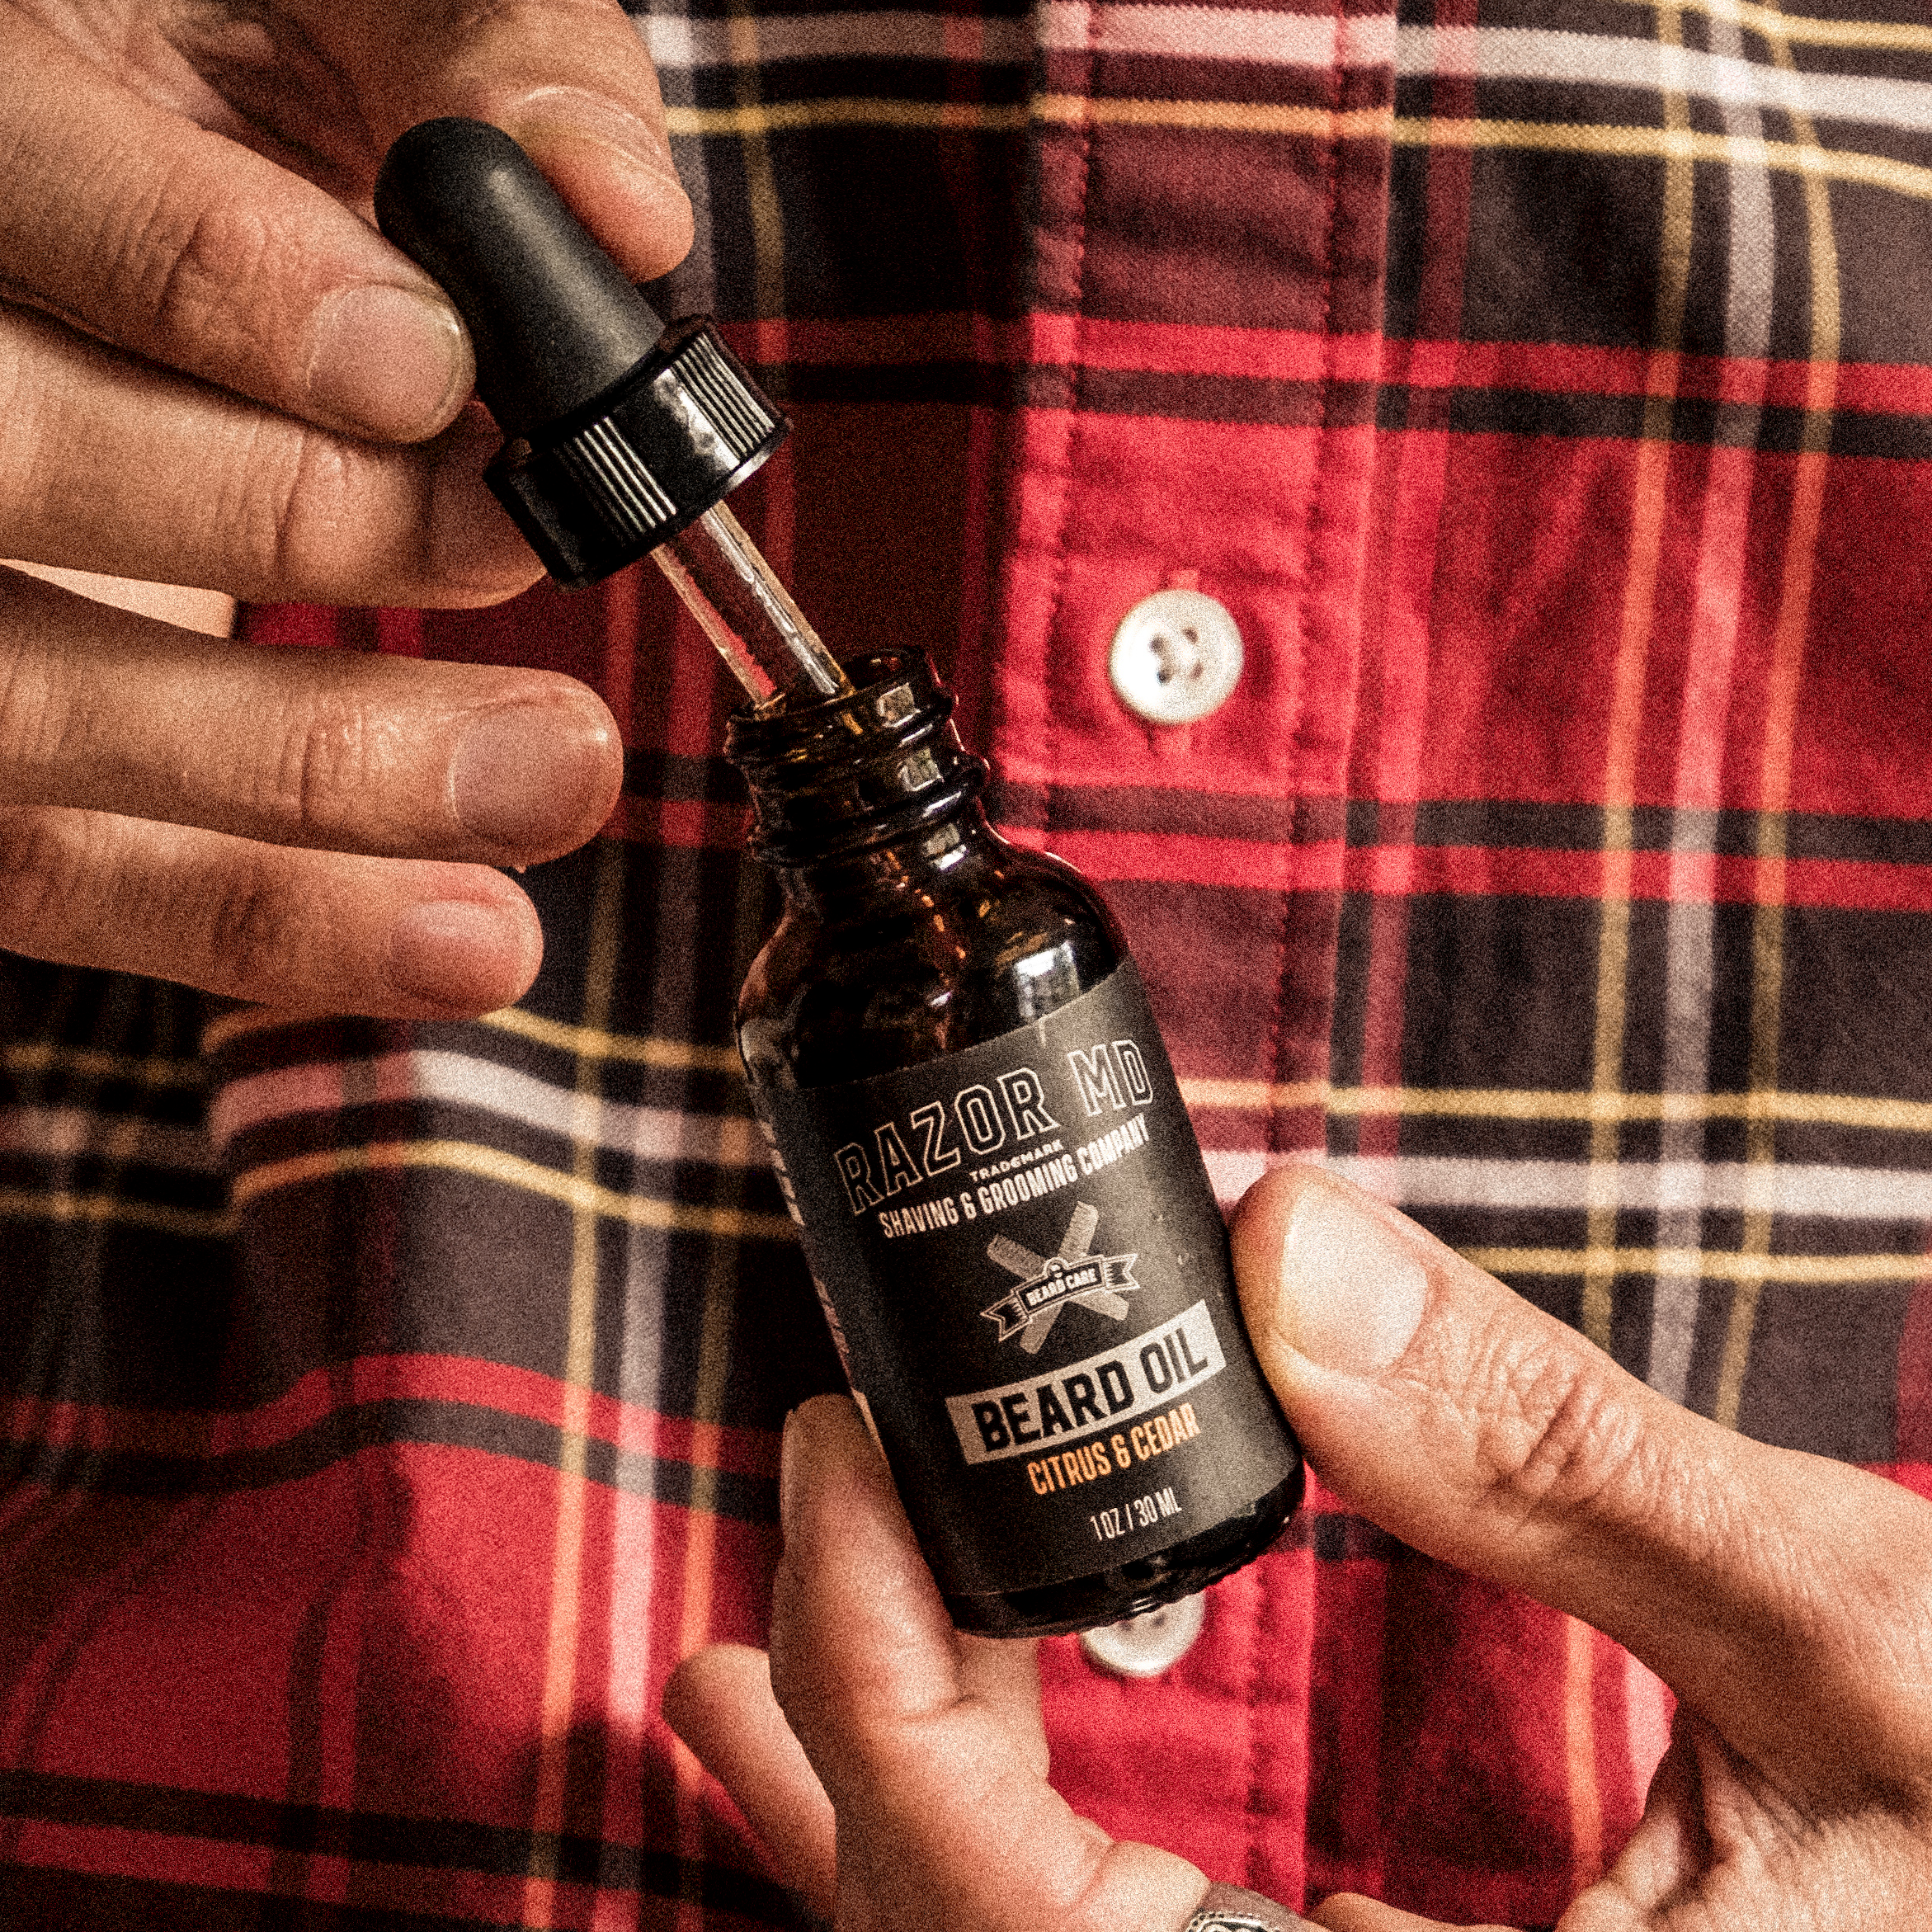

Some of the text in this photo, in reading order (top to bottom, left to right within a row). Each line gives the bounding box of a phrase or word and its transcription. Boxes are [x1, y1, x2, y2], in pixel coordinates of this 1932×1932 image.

[834, 1067, 1061, 1216] RAZOR
[1067, 1039, 1153, 1117] MD
[879, 1113, 1150, 1239] SHAVING & GROOMING COMPANY
[968, 1139, 1064, 1182] TRADEMARK
[971, 1327, 1209, 1453] BEARD OIL
[1027, 1402, 1201, 1495] CITRUS & CEDAR
[1090, 1486, 1182, 1541] 1 OZ / 30 ML
